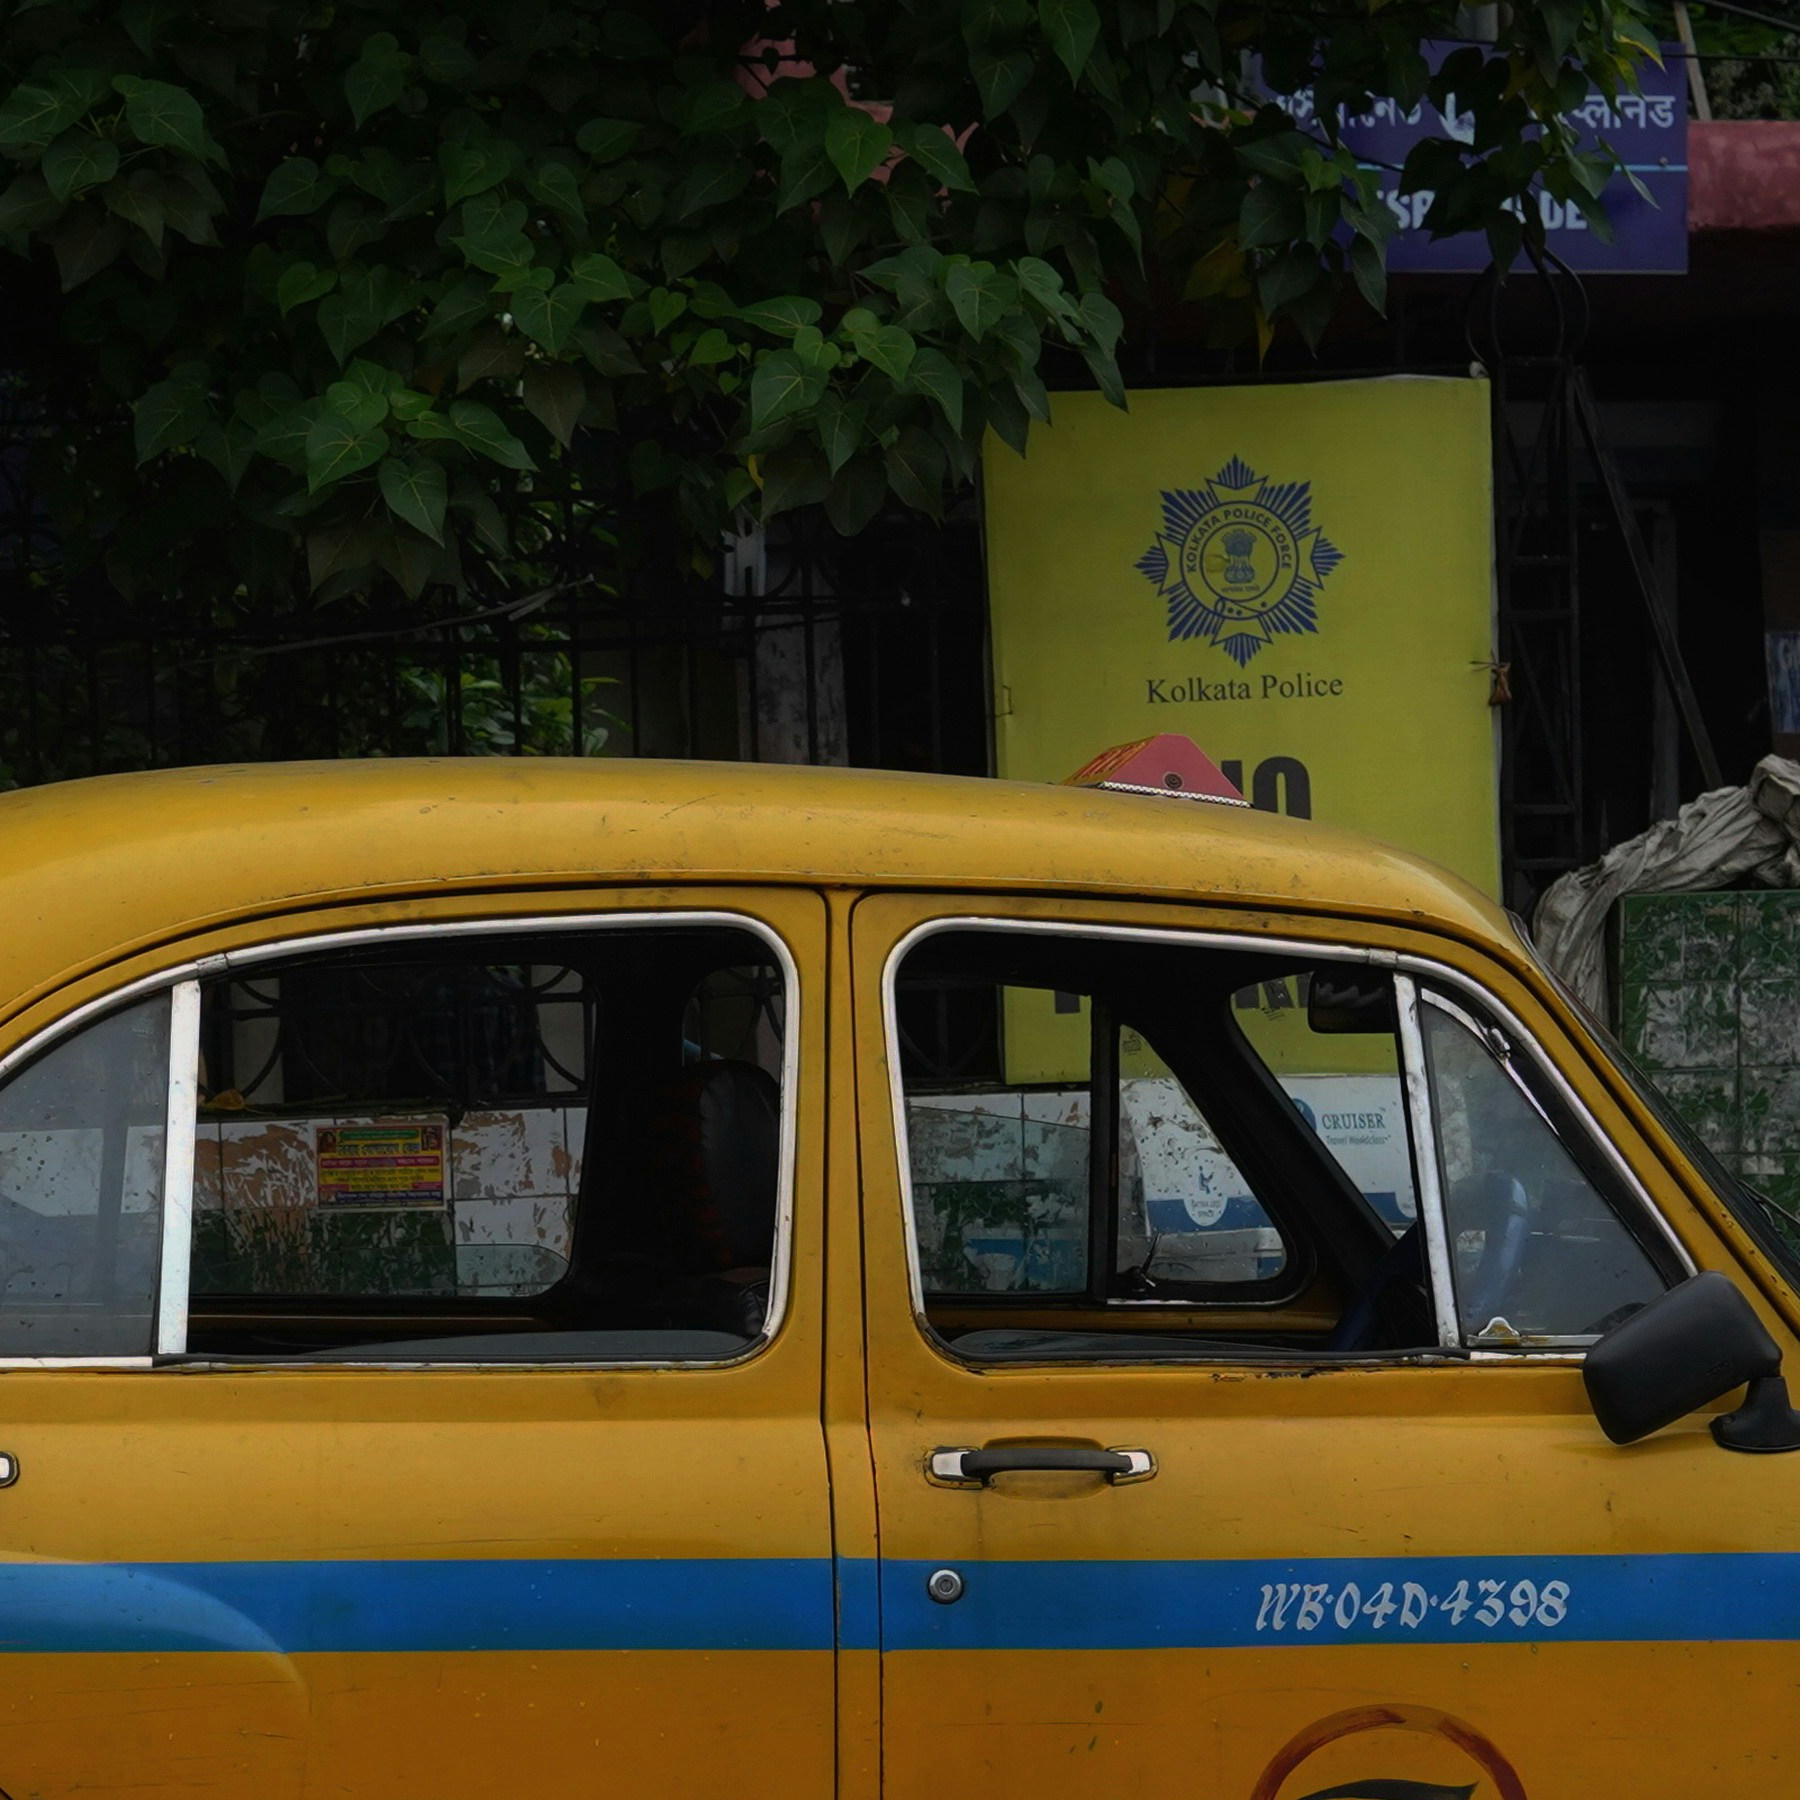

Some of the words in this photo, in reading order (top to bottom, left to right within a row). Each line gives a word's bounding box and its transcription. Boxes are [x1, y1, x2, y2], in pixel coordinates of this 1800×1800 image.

[1185, 514, 1222, 574] KOLKATA
[1223, 508, 1272, 528] POLICE
[1270, 525, 1293, 570] FORCE
[1146, 677, 1252, 704] Kolkata
[1260, 672, 1344, 699] Police
[1321, 1112, 1386, 1130] CRUISER
